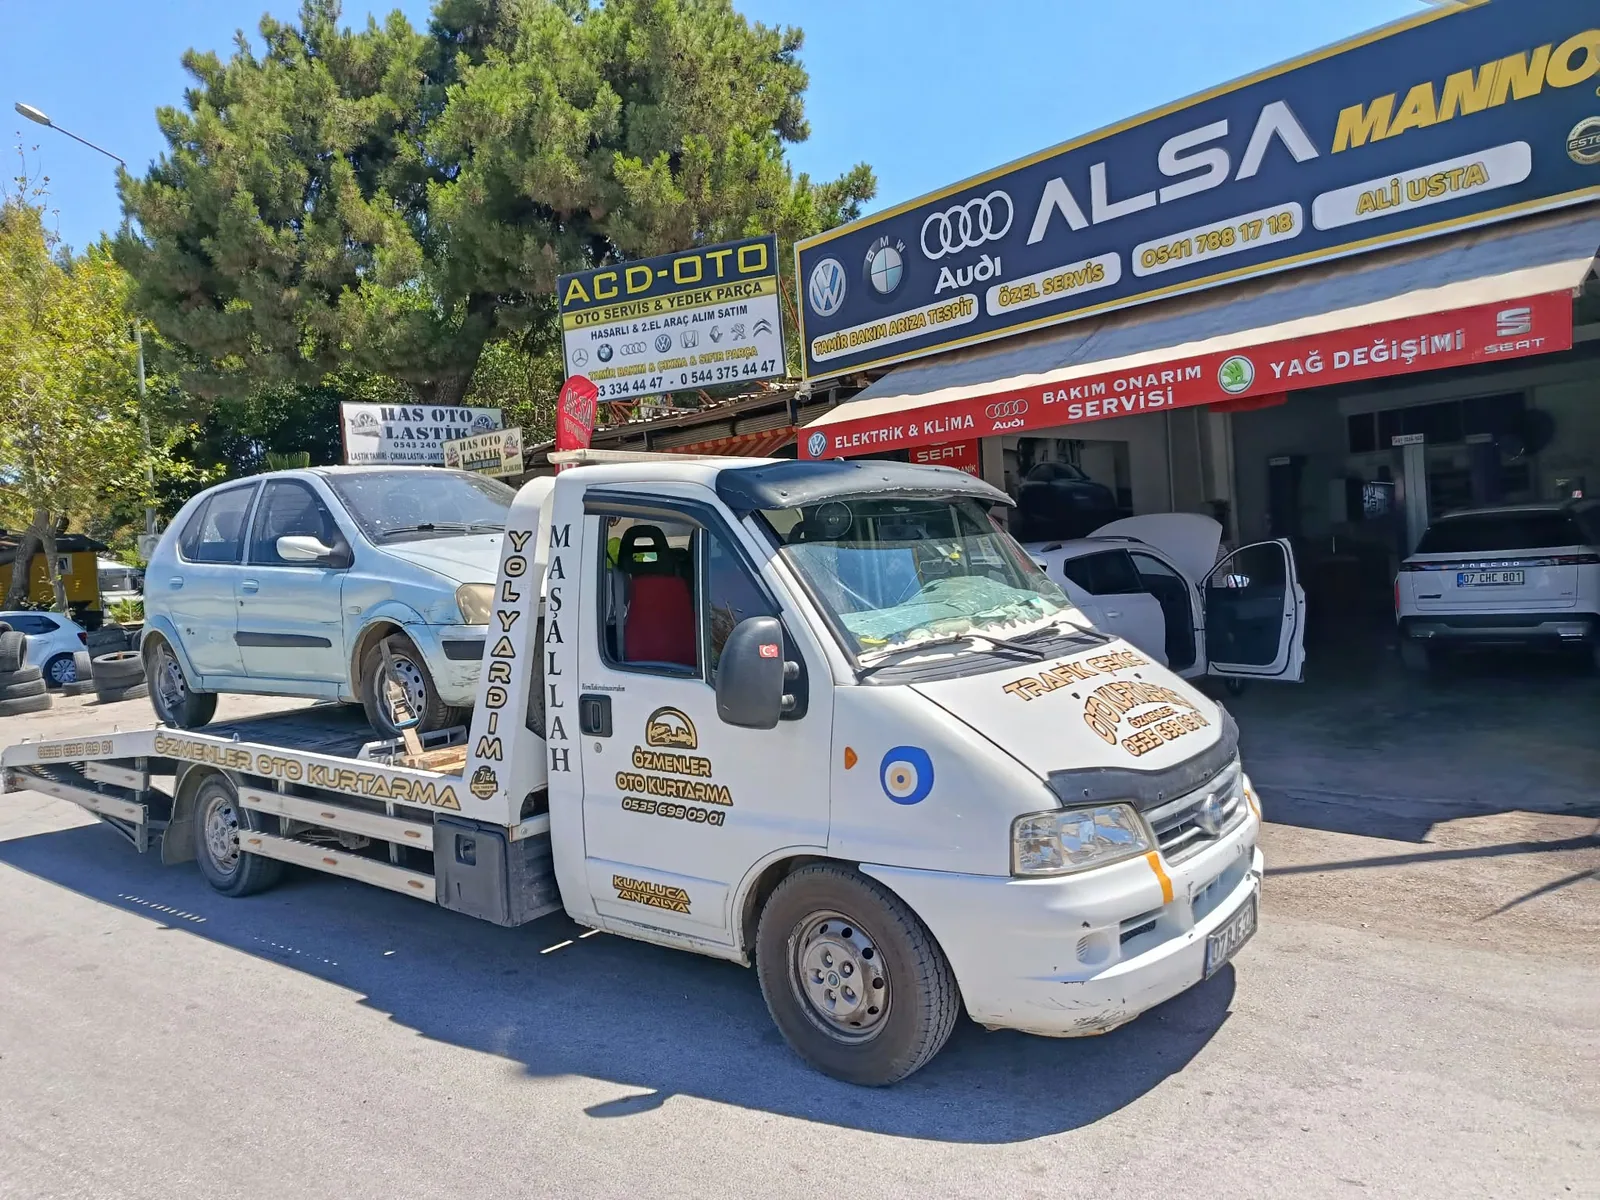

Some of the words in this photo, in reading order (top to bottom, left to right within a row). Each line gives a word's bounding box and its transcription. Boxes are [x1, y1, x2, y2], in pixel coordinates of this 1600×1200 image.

[1026, 100, 1320, 246] ALSA
[1355, 177, 1402, 216] ALİ
[1406, 160, 1489, 202] USTA
[1140, 239, 1193, 270] 0541
[1195, 226, 1237, 253] 788
[1238, 218, 1264, 242] 17
[1265, 211, 1294, 235] 18
[563, 243, 768, 306] ACD-OTO
[933, 254, 1002, 295] Audi
[997, 283, 1040, 308] ÖZEL
[1042, 261, 1105, 296] SERVİS
[575, 310, 600, 326] OTO
[604, 300, 650, 320] SERVİS
[653, 299, 664, 312] &
[667, 290, 713, 309] YEDEK
[716, 281, 763, 301] PARÇA
[590, 326, 630, 341] HASARLI
[632, 322, 639, 334] &
[641, 321, 662, 333] 2.EL
[663, 315, 689, 329] ARAÇ
[691, 309, 716, 323] ALIM
[717, 304, 748, 319] SATIM
[813, 332, 849, 356] TAMİR
[849, 323, 887, 348] BAKIM
[888, 313, 928, 338] ARIZA
[928, 295, 975, 325] TESPİT
[1269, 349, 1324, 380] YAĞ
[1333, 328, 1465, 367] DEĞİŞİMİ
[1484, 337, 1545, 355] SEAT
[609, 381, 630, 396] 334
[632, 379, 646, 392] 44
[649, 376, 664, 390] 47
[680, 372, 688, 385] 0
[691, 370, 714, 384] 544
[716, 365, 739, 380] 375
[742, 362, 758, 376] 44
[761, 359, 776, 373] 47
[1042, 381, 1106, 405] BAKIM
[1112, 364, 1202, 393] ONARIM
[380, 407, 425, 423] HAS
[431, 408, 473, 424] OTO
[1067, 385, 1174, 420] SERVİSİ
[386, 424, 469, 441] LASTİK
[460, 439, 478, 452] HAS
[481, 435, 501, 447] OTO
[834, 425, 903, 449] ELEKTRİK
[907, 422, 919, 437] &
[924, 414, 975, 435] KLİMA
[991, 417, 1025, 431] Audi
[916, 444, 967, 463] SEAT
[501, 529, 533, 603] YOL
[1463, 573, 1476, 584] 07
[1480, 572, 1498, 583] CHC
[1502, 572, 1521, 583] 801
[544, 522, 572, 773] MAŞALLAH
[474, 609, 521, 763] YARDIM
[1001, 661, 1099, 702] TRAFİK
[1083, 694, 1122, 746] OTO
[1120, 727, 1165, 758] 0535
[1154, 719, 1187, 741] 698
[154, 731, 253, 772] ÖZMENLER
[257, 753, 303, 781] OTO
[306, 762, 462, 811] KURTARMA
[631, 745, 712, 778] ÖZMENLER
[615, 772, 646, 794] OTO
[646, 774, 734, 806] KURTARMA
[621, 796, 657, 814] 0535
[656, 802, 686, 819] 698
[686, 807, 707, 824] 09
[707, 810, 726, 827] 01
[612, 874, 692, 906] KUMLUCA
[617, 888, 692, 915] ANTALYA
